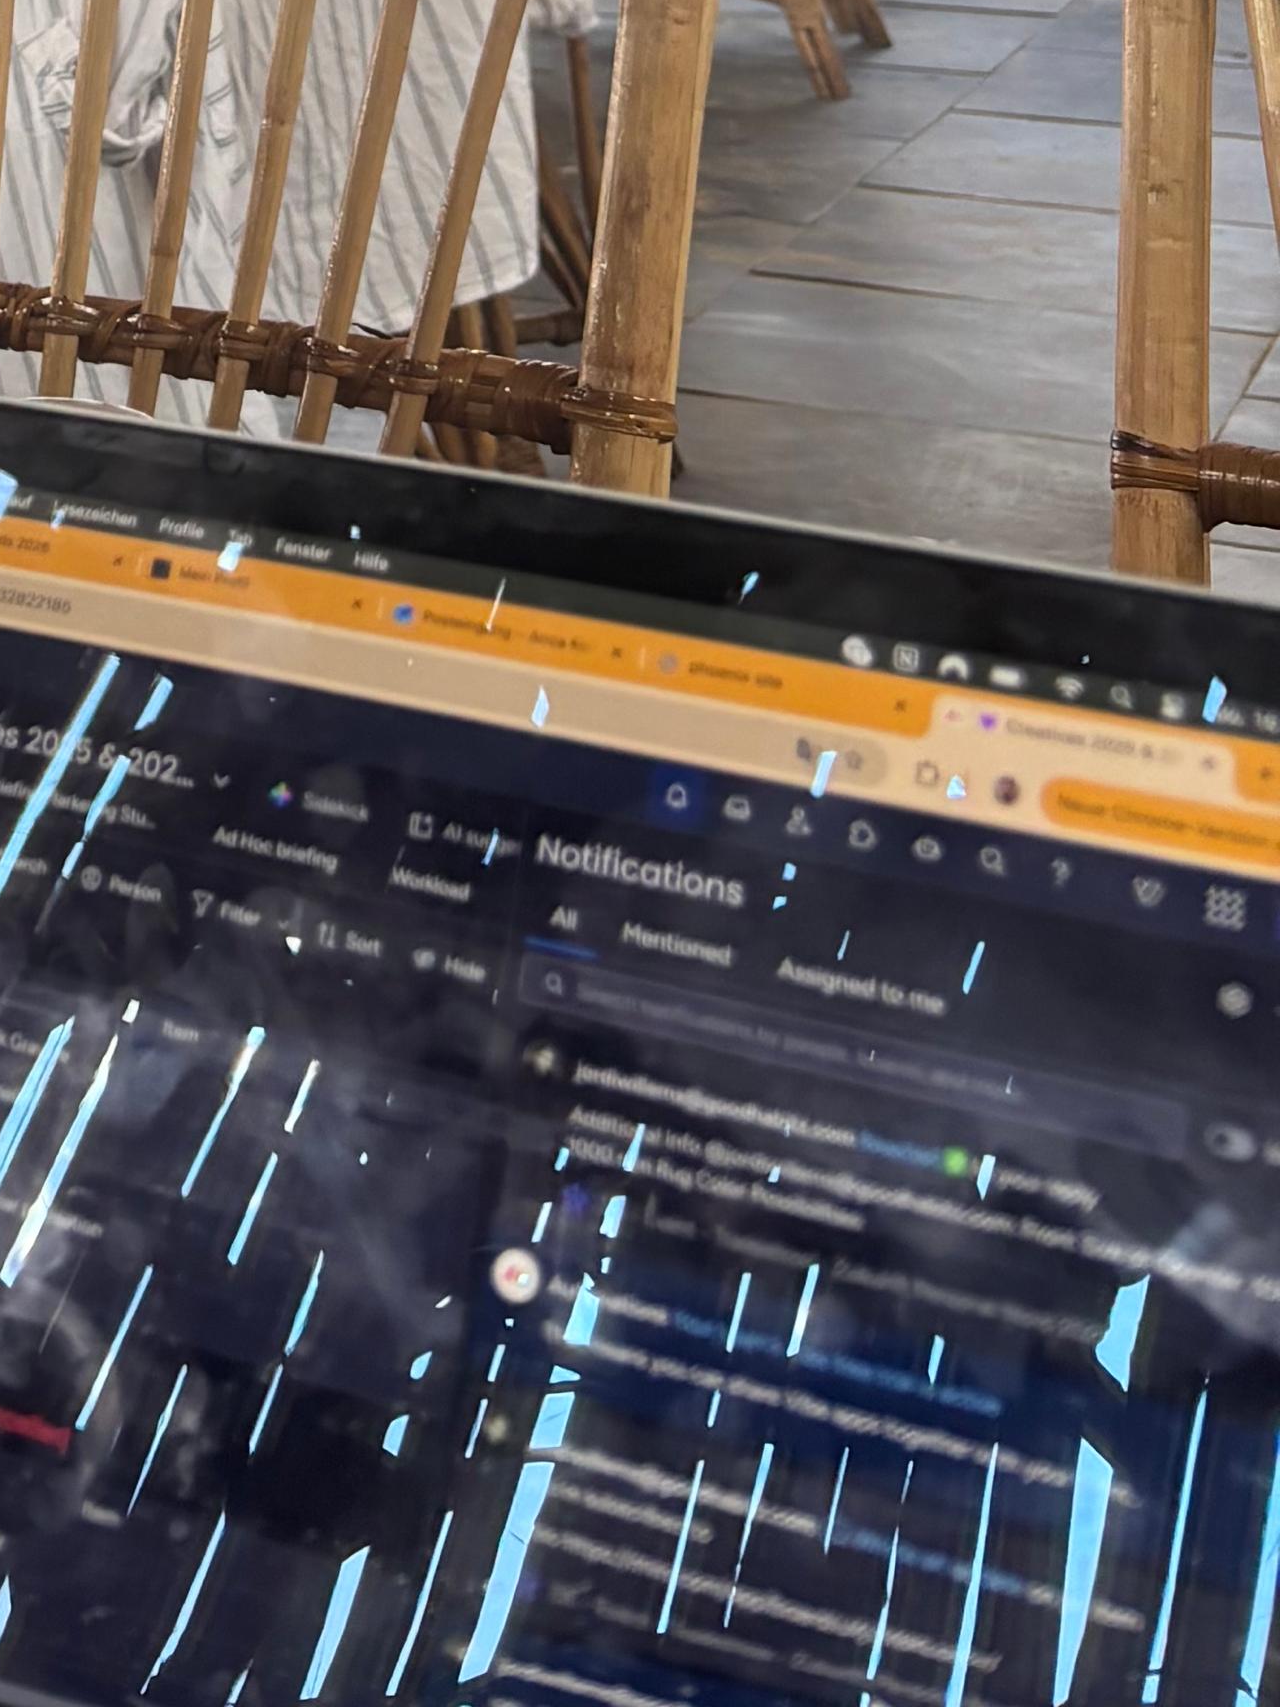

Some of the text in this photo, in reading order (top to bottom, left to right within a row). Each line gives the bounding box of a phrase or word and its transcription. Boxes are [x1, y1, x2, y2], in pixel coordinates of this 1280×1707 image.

[159, 517, 205, 539] Profile
[275, 537, 333, 561] Fenster
[353, 550, 389, 572] Hilfe
[23, 724, 93, 765] 205
[213, 825, 339, 876] Ad Hoc briefing
[108, 876, 162, 903] Person
[391, 866, 471, 903] Workload
[535, 834, 746, 909] Notifications
[219, 900, 261, 927] Filter
[549, 904, 580, 932] All
[344, 931, 382, 959] Sort
[619, 920, 734, 969] Mentioned
[443, 954, 487, 983] Hide
[775, 955, 948, 1018] Assigned to me
